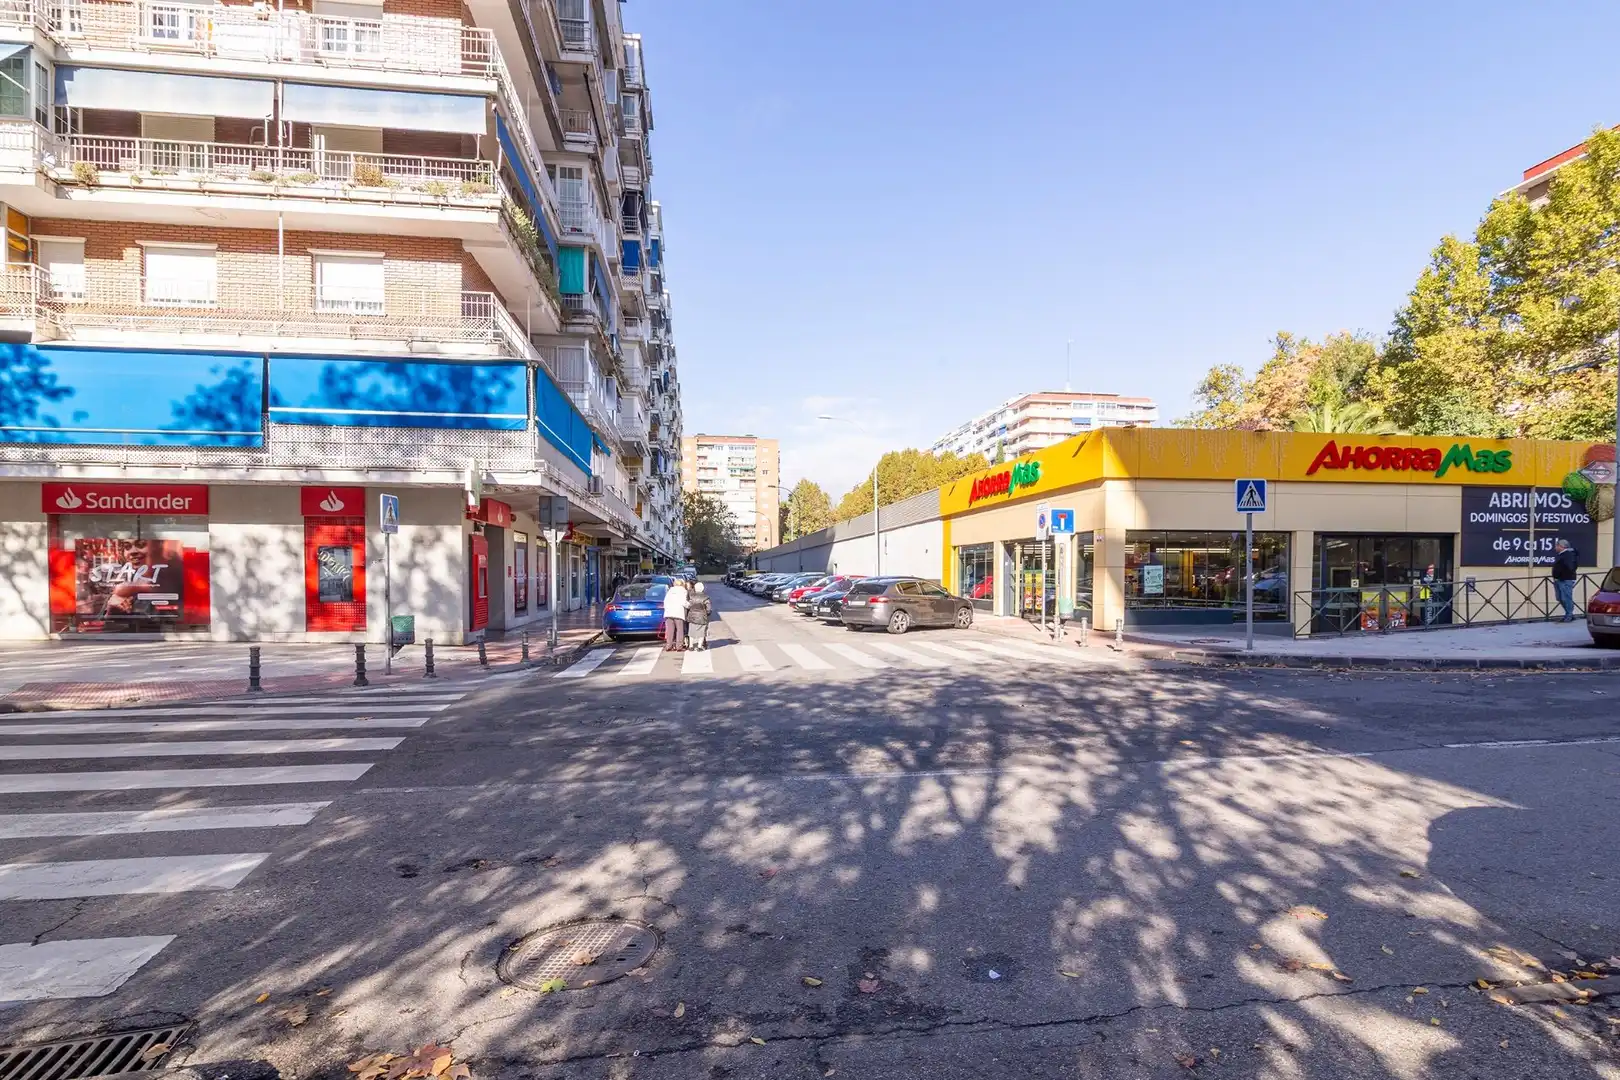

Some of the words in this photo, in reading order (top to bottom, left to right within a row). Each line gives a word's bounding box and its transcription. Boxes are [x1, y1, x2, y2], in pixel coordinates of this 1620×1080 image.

[86, 492, 193, 510] Santander
[1470, 512, 1528, 523] DOMINGOS
[1533, 513, 1541, 522] Y
[1543, 513, 1590, 523] FESTIVOS
[1493, 536, 1511, 551] de
[1513, 537, 1521, 550] 9
[1540, 537, 1553, 551] 15
[89, 562, 169, 584] START
